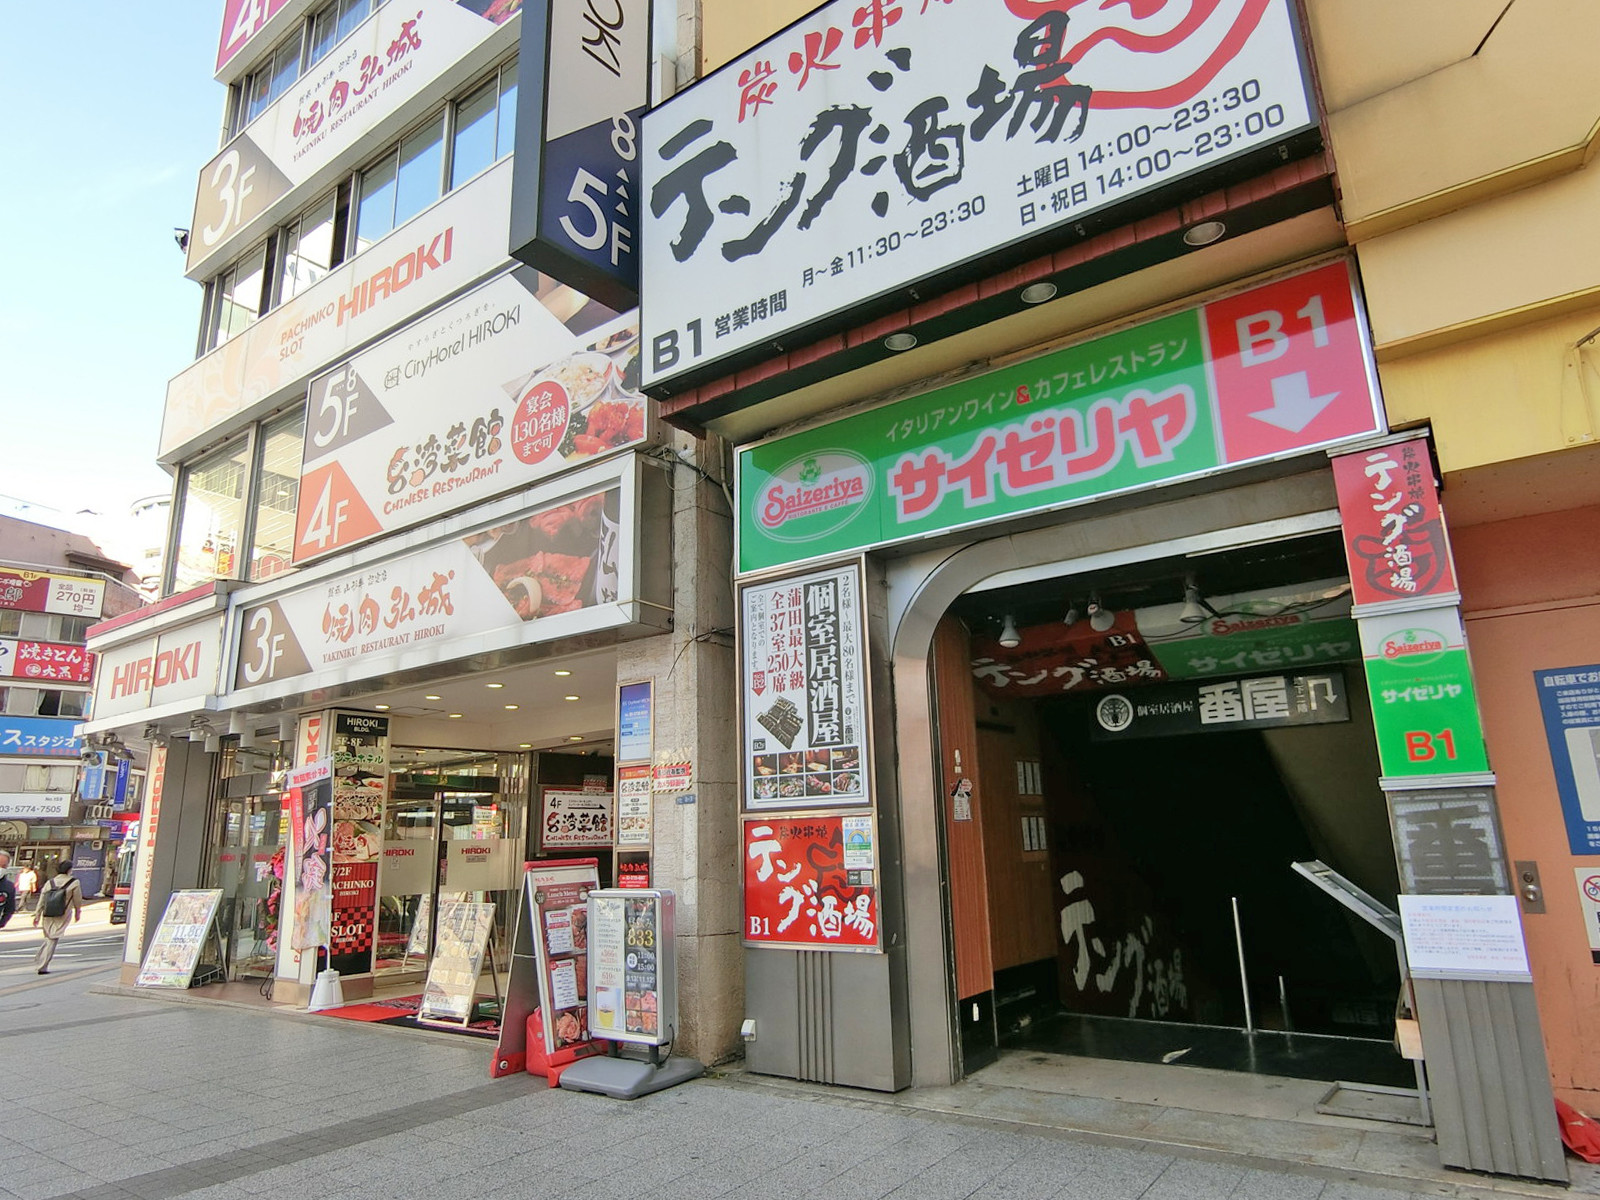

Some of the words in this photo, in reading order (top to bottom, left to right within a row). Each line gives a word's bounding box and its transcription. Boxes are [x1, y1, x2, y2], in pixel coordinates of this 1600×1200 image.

[738, 0, 957, 123] 炭火串
[330, 87, 379, 134] RESTAURANT
[382, 60, 413, 91] HIROKI
[650, 10, 1093, 263] テング酒場
[203, 150, 258, 247] 3F
[1016, 158, 1070, 198] 土曜日
[1020, 181, 1088, 226] 日・祝日
[336, 226, 453, 327] HIROKI
[281, 303, 335, 345] PACHINKO
[468, 304, 521, 349] HIROKI
[653, 318, 702, 374] B1
[714, 290, 787, 340] 営業時間
[1235, 295, 1330, 368] B1
[280, 336, 305, 362] SLOT
[513, 405, 566, 444] 130名様
[526, 391, 553, 415] 宴会
[522, 433, 554, 457] まで可
[889, 386, 1195, 520] サイゼリヤ
[383, 488, 430, 515] CHINESE
[432, 458, 503, 497] RESTAURANT
[763, 476, 863, 522] Saizeriya
[301, 473, 348, 550] 4F
[1364, 452, 1417, 592] テング酒場
[56, 590, 95, 606] 270円
[322, 570, 455, 643] 焼肉弘城
[20, 642, 82, 664] 焼きとん
[245, 607, 284, 682] 3F
[323, 646, 358, 664] YAKINIKU
[360, 633, 411, 655] RESTAURANT
[414, 623, 446, 642] HIROKI
[767, 591, 789, 694] 全37室250席
[787, 587, 805, 691] 蒲田最大級
[1109, 633, 1136, 648] B1
[1188, 641, 1351, 673] サイゼリヤ
[1384, 641, 1442, 658] Saizeriya
[111, 641, 201, 700] HIROKI
[807, 580, 844, 746] 個室居酒屋
[970, 658, 1161, 690] テング酒場
[1543, 671, 1600, 688] 自転車でお
[1199, 675, 1290, 724] 番屋
[1381, 683, 1462, 704] サイゼリヤ
[347, 716, 379, 728] HIROKI
[1405, 728, 1458, 762] B1
[550, 797, 562, 809] 4F
[331, 879, 375, 891] ACHINKO
[748, 826, 875, 939] テング酒場
[330, 923, 365, 938] SLOT
[627, 929, 654, 947] 833
[750, 916, 770, 935] B1
